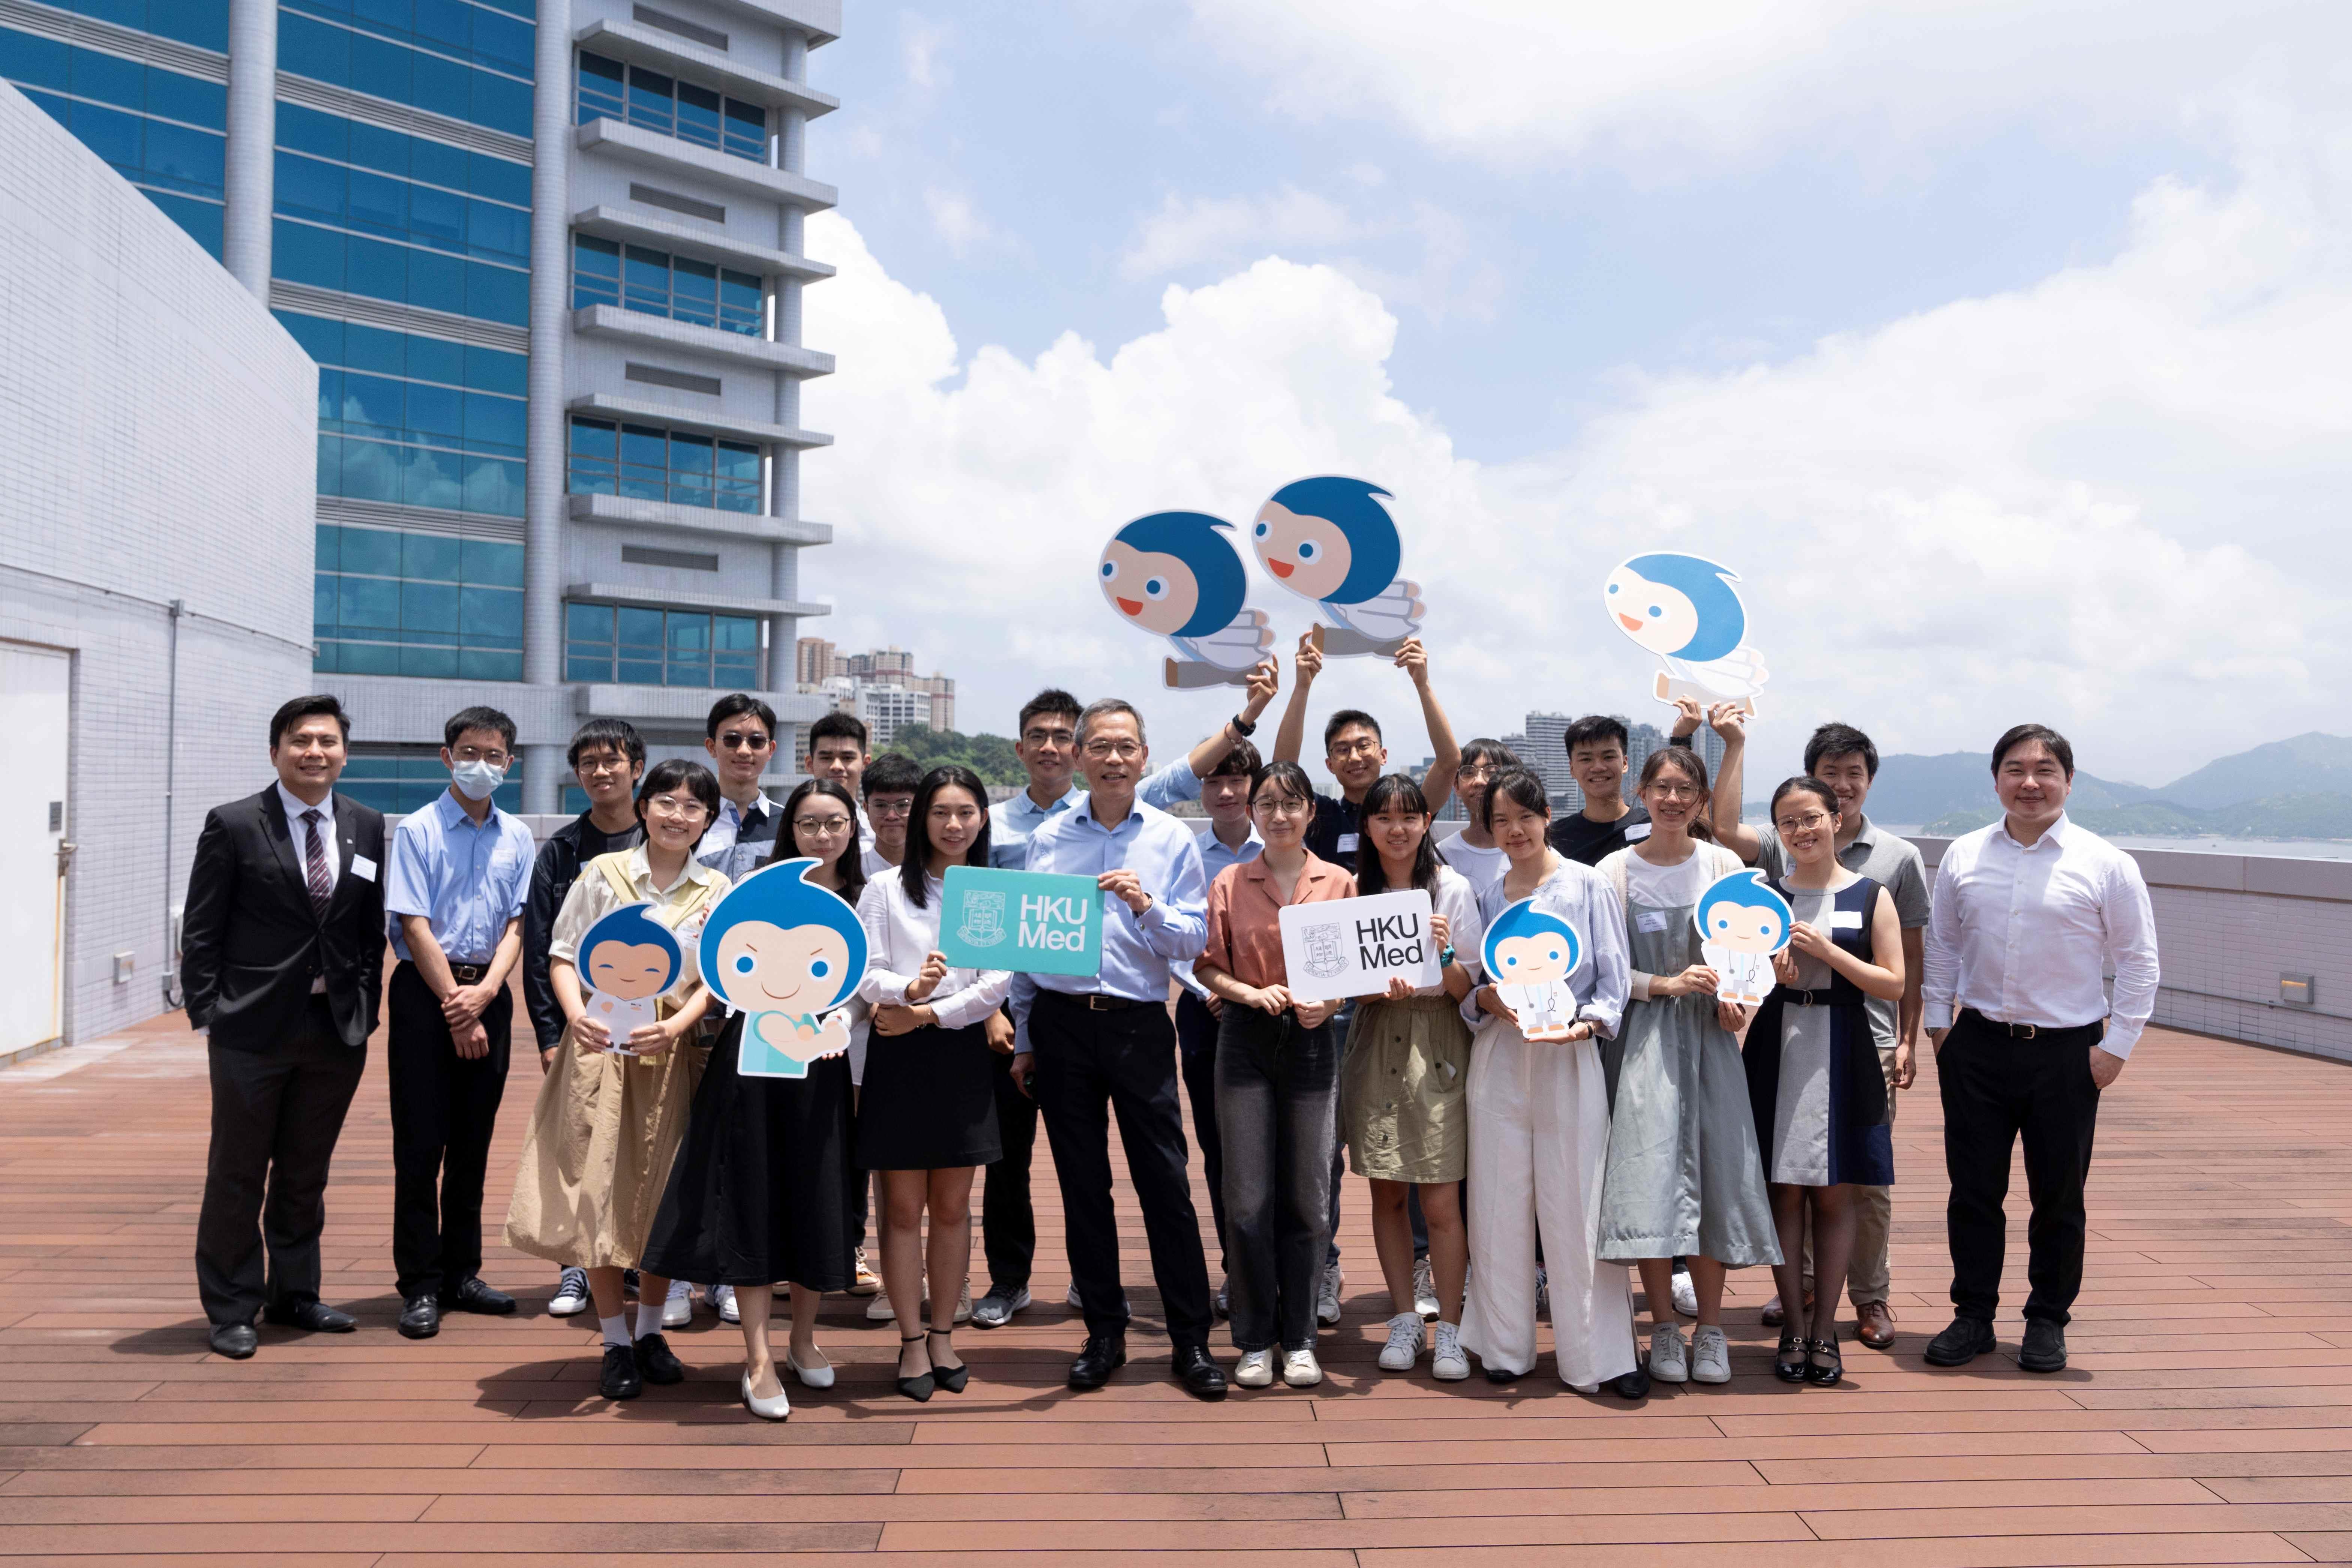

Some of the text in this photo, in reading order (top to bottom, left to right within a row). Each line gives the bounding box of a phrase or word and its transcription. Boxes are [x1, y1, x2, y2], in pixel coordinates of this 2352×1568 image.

[1020, 894, 1088, 925] HKU
[1018, 921, 1086, 952] Med
[1356, 913, 1419, 944] HKU
[1359, 939, 1424, 970] Med
